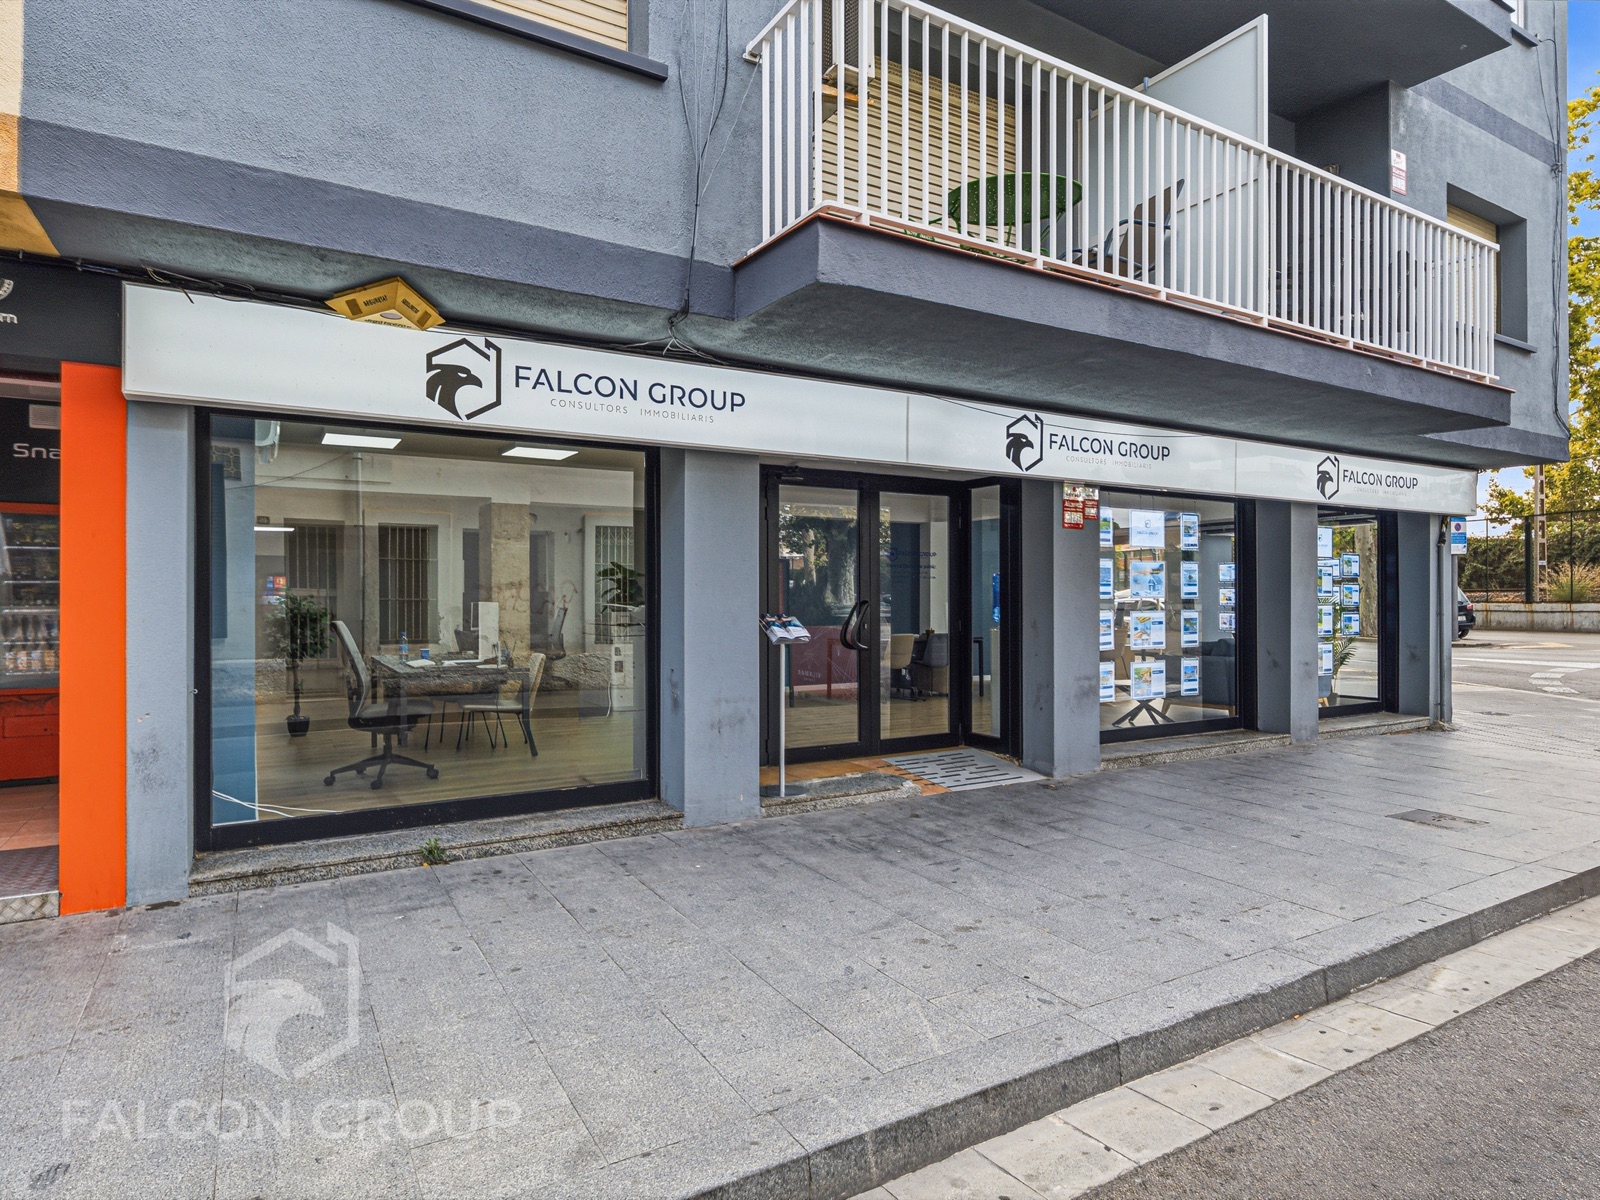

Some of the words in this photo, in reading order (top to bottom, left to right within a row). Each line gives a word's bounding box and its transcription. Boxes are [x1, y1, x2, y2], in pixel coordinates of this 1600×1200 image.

[514, 365, 638, 401] FALCON
[648, 382, 746, 412] GROUP
[550, 398, 628, 414] CONSULTORS
[640, 408, 715, 423] IMMOBILIARIS
[1049, 433, 1113, 456] FALCON
[1118, 441, 1171, 461] GROUP
[1342, 469, 1383, 486] FALCON
[1385, 474, 1418, 490] GROUP
